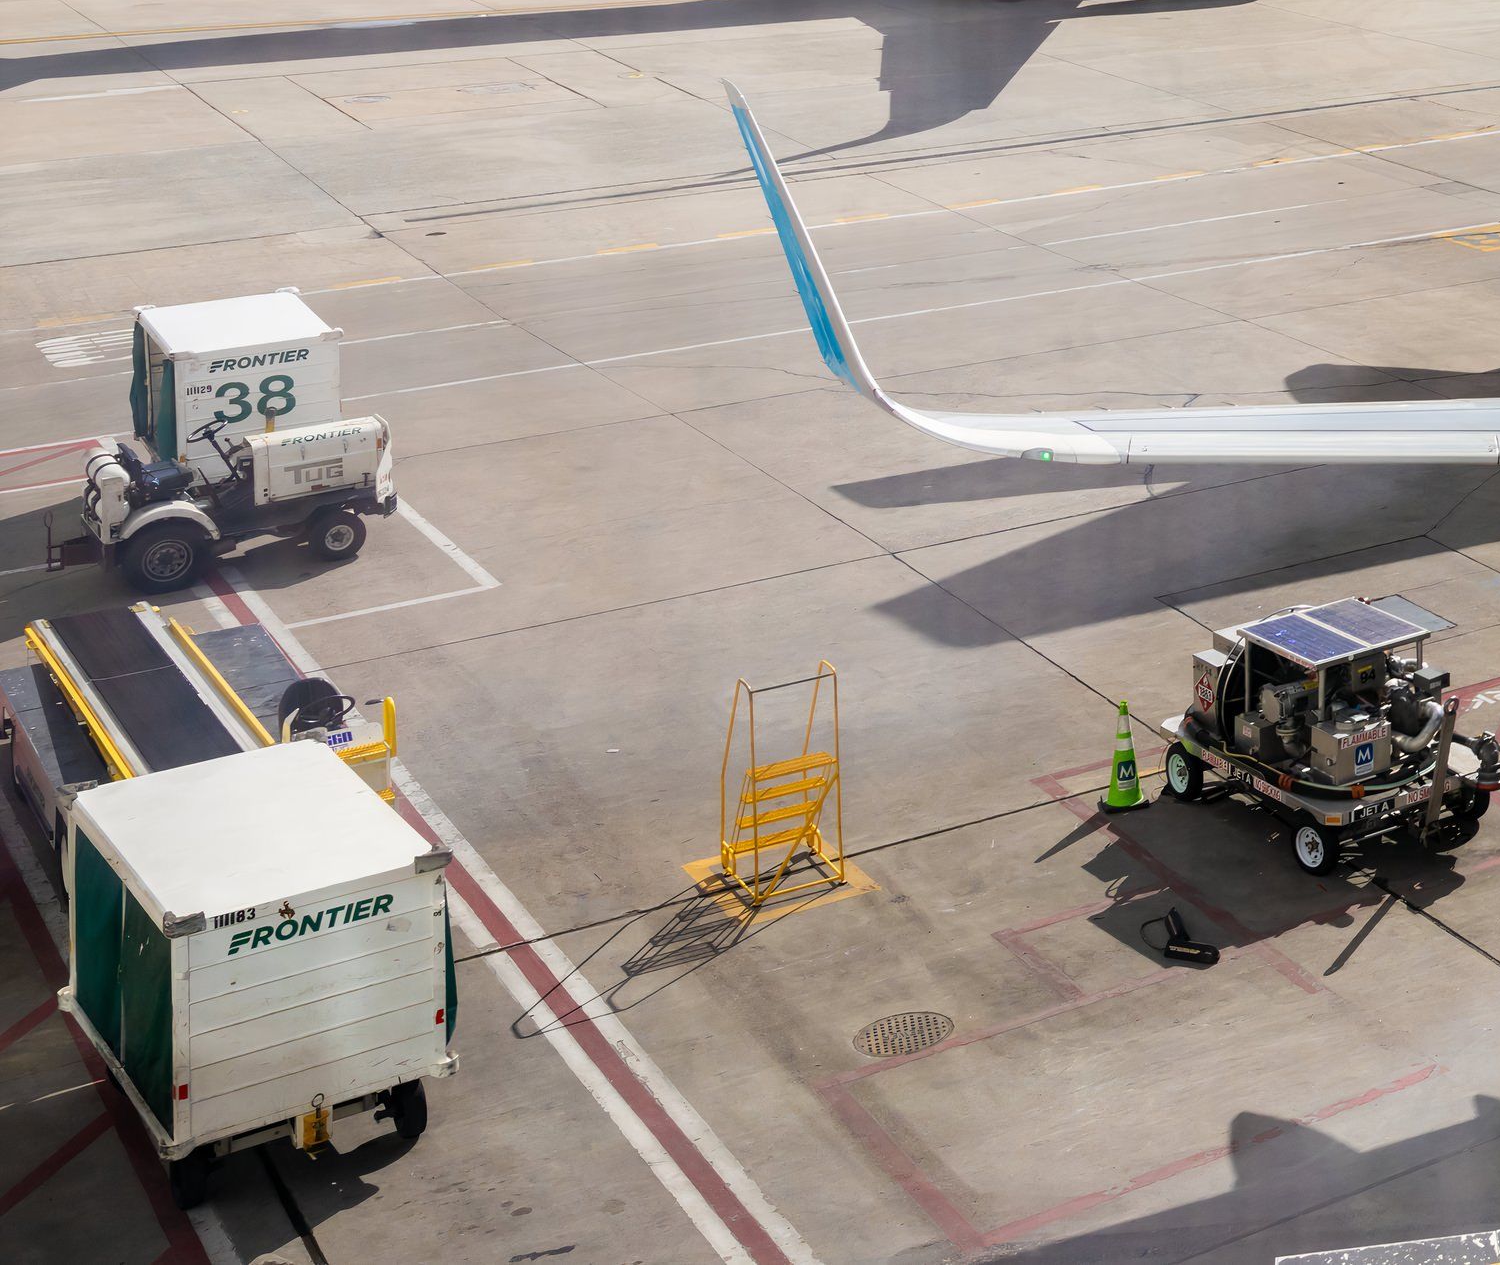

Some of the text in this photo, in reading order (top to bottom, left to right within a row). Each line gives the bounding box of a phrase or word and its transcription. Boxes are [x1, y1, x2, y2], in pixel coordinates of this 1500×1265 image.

[209, 348, 310, 374] FRONTIER
[213, 374, 296, 424] 38
[281, 426, 363, 447] FRONTIER
[284, 457, 344, 485] TUG
[1359, 668, 1375, 684] 94
[1342, 727, 1387, 749] FLAMMABLE
[1356, 749, 1371, 764] M
[1119, 763, 1134, 779] M
[1360, 792, 1417, 819] JET A NO
[227, 893, 394, 956] FRONTIER
